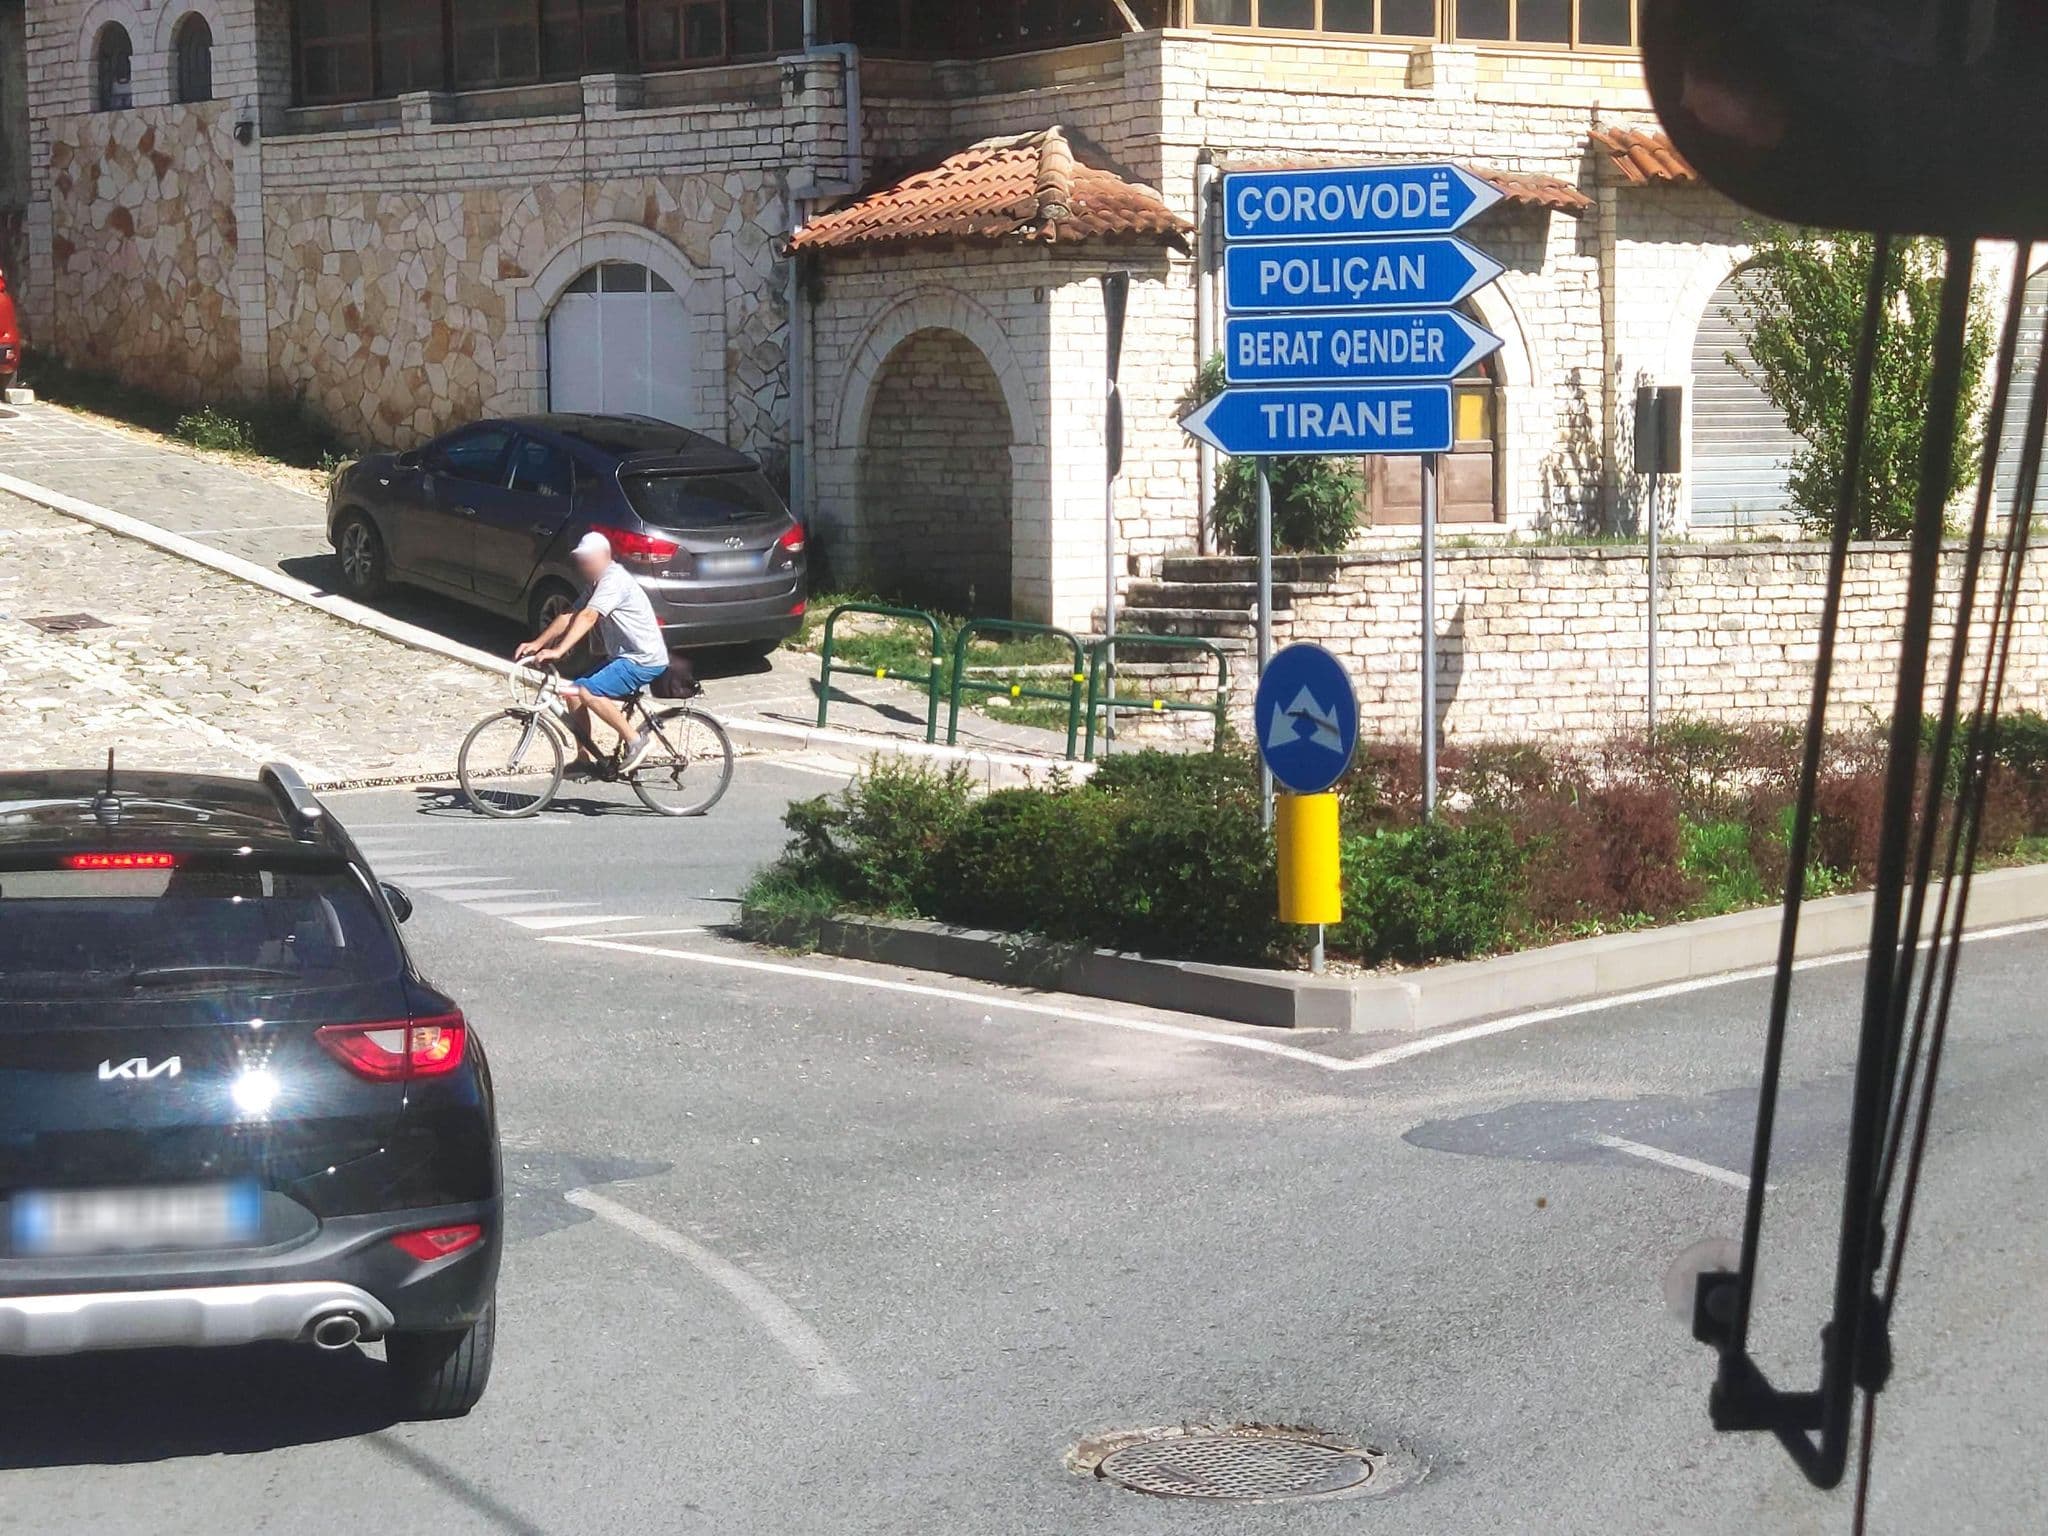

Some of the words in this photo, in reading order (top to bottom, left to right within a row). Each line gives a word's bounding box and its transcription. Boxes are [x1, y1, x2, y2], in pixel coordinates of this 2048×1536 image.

[1237, 172, 1450, 229] ÇOROVODË
[1260, 254, 1425, 299] POLIÇAN
[1239, 330, 1322, 366] BERAT
[1331, 319, 1444, 368] QENDËR
[1260, 400, 1414, 439] TIRANE
